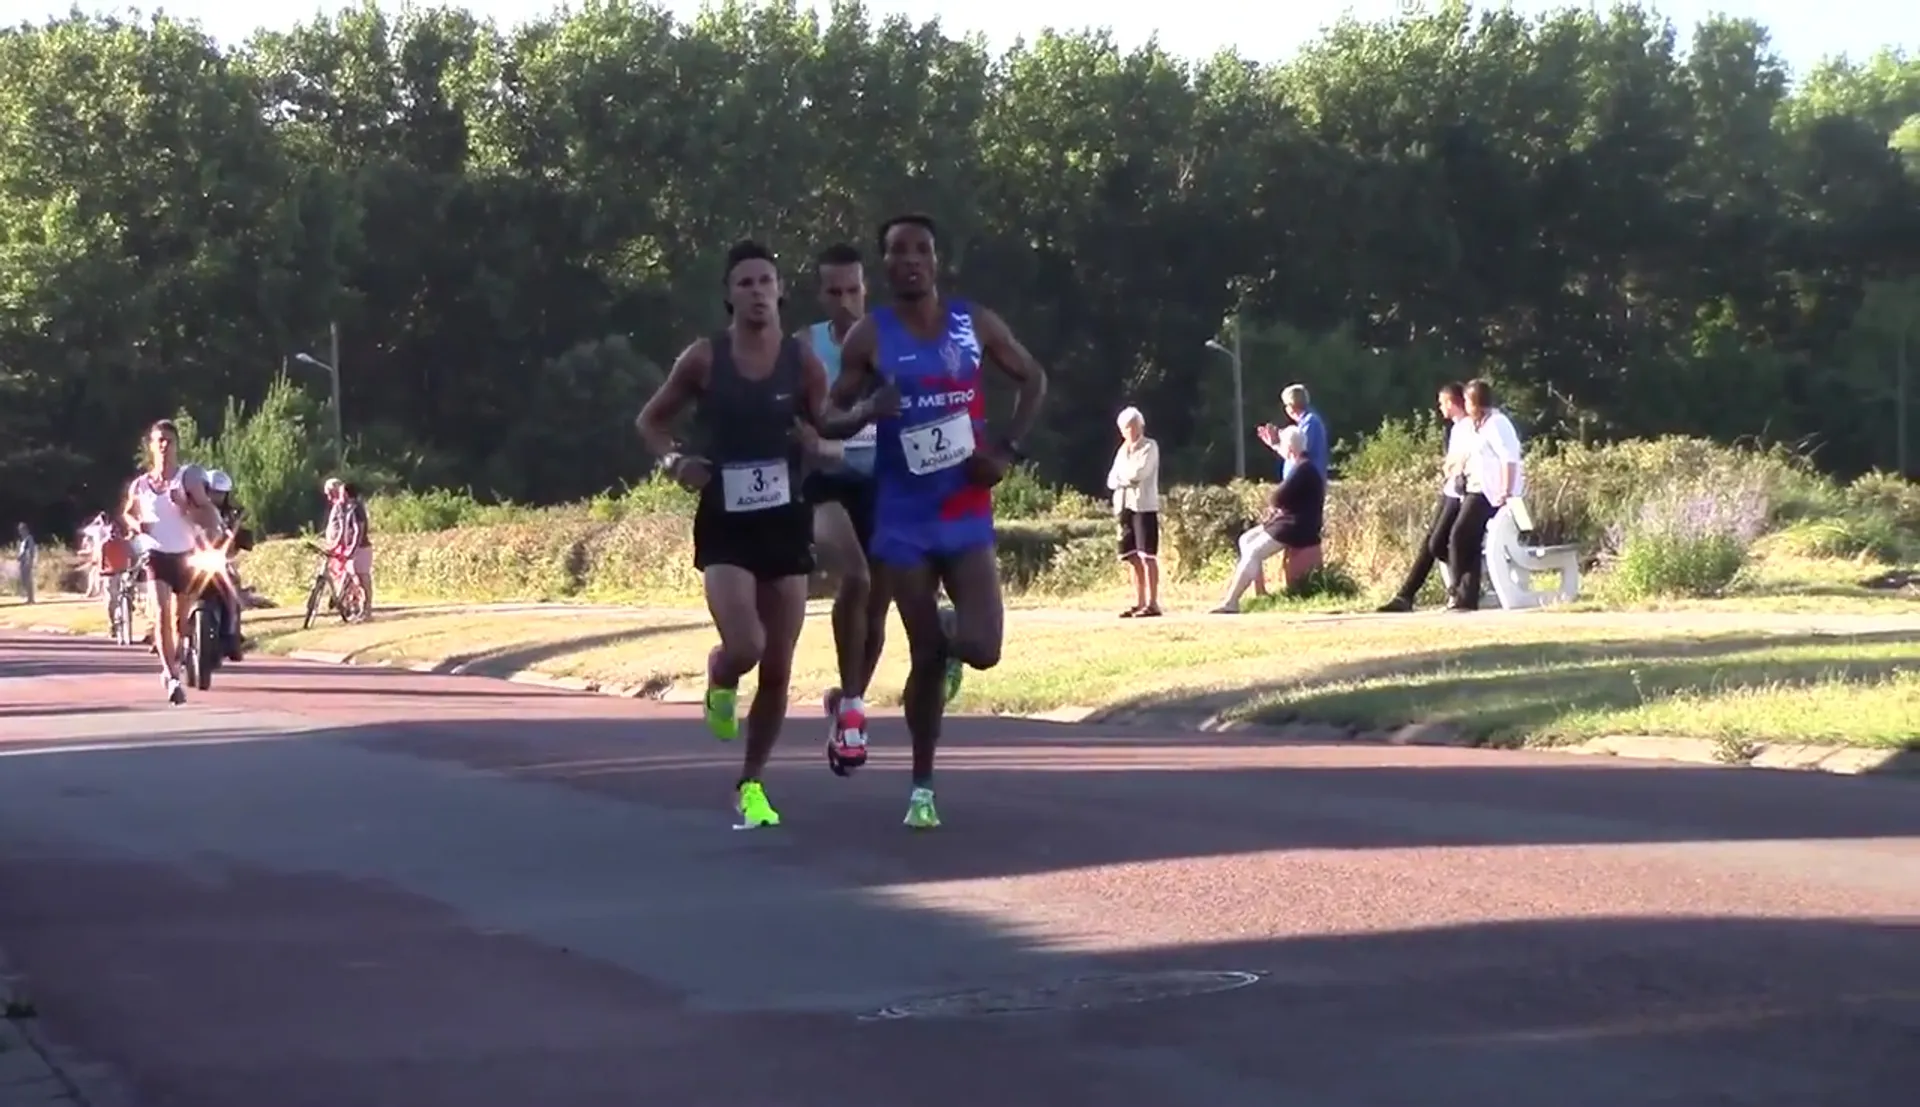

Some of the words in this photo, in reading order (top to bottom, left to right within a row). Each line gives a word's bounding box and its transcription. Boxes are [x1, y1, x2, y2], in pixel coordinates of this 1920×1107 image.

[917, 388, 976, 407] METRO
[931, 427, 946, 452] 2
[752, 468, 764, 492] 3
